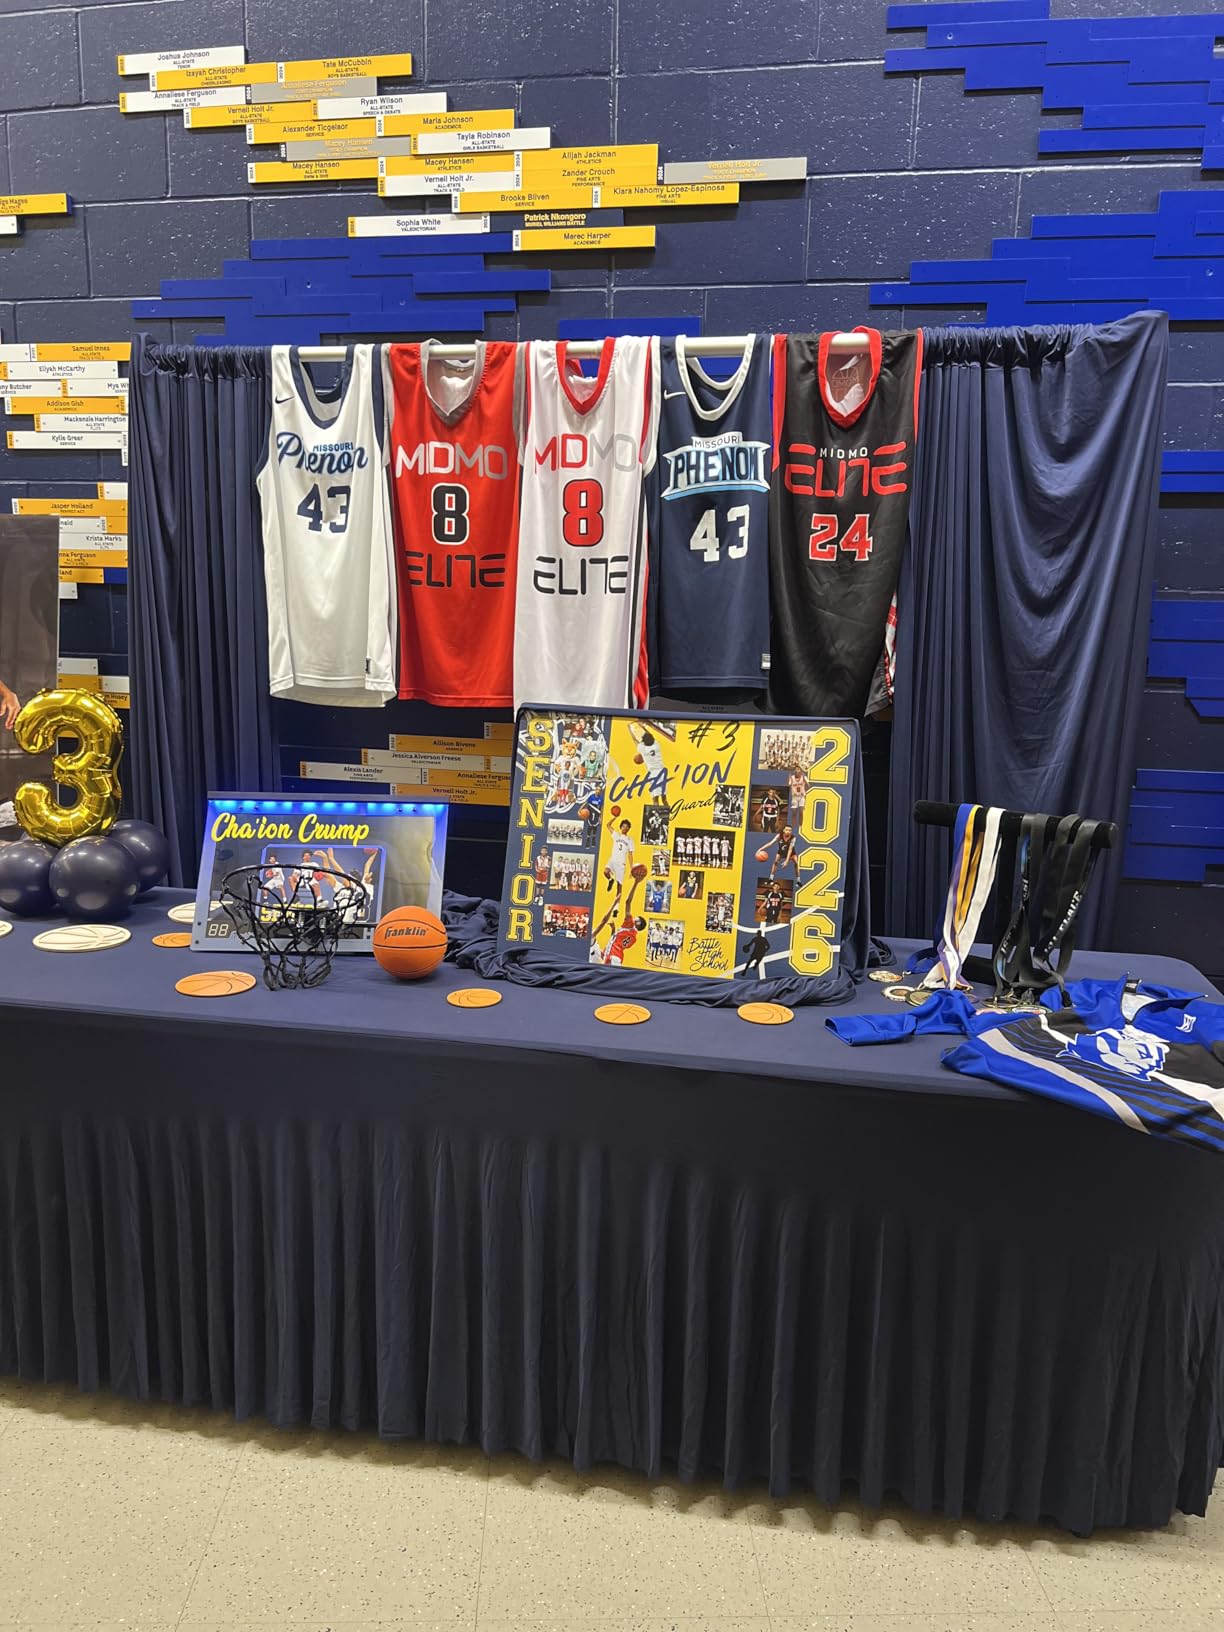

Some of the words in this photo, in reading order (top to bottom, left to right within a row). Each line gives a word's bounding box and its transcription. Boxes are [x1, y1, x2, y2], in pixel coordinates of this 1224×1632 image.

[157, 53, 181, 61] Joshua
[182, 51, 210, 59] Johnson
[322, 60, 337, 68] Tate
[338, 58, 372, 68] McCubbin
[208, 66, 246, 76] Christopher
[154, 91, 186, 99] Annaliese
[186, 89, 217, 98] Ferguson
[360, 97, 378, 107] Ryan
[379, 96, 403, 104] Wilson
[423, 117, 442, 125] Maria
[443, 115, 474, 124] Johnson
[282, 125, 315, 134] Alexander
[456, 133, 475, 141] Tayla
[477, 131, 511, 139] Robinson
[584, 150, 617, 159] Jackman
[292, 162, 313, 170] Macey
[315, 161, 340, 169] Hansen
[425, 158, 447, 167] Macey
[448, 157, 475, 165] Hansen
[562, 169, 587, 177] Zander
[588, 167, 616, 176] Crouch
[424, 175, 449, 183] Vernell
[449, 174, 464, 182] Holt
[465, 174, 475, 182] Jr.
[613, 187, 632, 195] Kiara
[634, 185, 664, 195] Nahomy
[666, 184, 726, 194] Lopez-Espinosa
[500, 194, 526, 202] Brooke
[396, 218, 420, 227] Sophia
[421, 218, 441, 226] White
[524, 213, 550, 222] Patrick
[550, 213, 587, 222] Nkongoro
[586, 231, 612, 241] Harper
[57, 365, 86, 373] McCarthy
[313, 442, 354, 452] MISSOURI
[694, 435, 741, 449] MISSOURI
[819, 446, 869, 459] MIDMO
[395, 441, 508, 481] MIDMO
[784, 441, 908, 498] ELITE
[297, 483, 352, 534] 43
[431, 482, 470, 546] 8
[562, 478, 604, 548] 8
[690, 504, 750, 562] 43
[808, 512, 873, 562] 24
[405, 550, 507, 588] ELITE
[533, 555, 630, 596] ELITE
[14, 687, 124, 849] 3
[609, 748, 738, 803] CHA'ION
[211, 812, 294, 843] Cha'ion
[298, 813, 370, 847] Crump
[506, 717, 552, 943] SENIOR
[788, 726, 851, 978] 2026
[207, 923, 229, 938] 88
[687, 937, 722, 955] Battle
[698, 946, 724, 963] High
[690, 956, 729, 972] School
